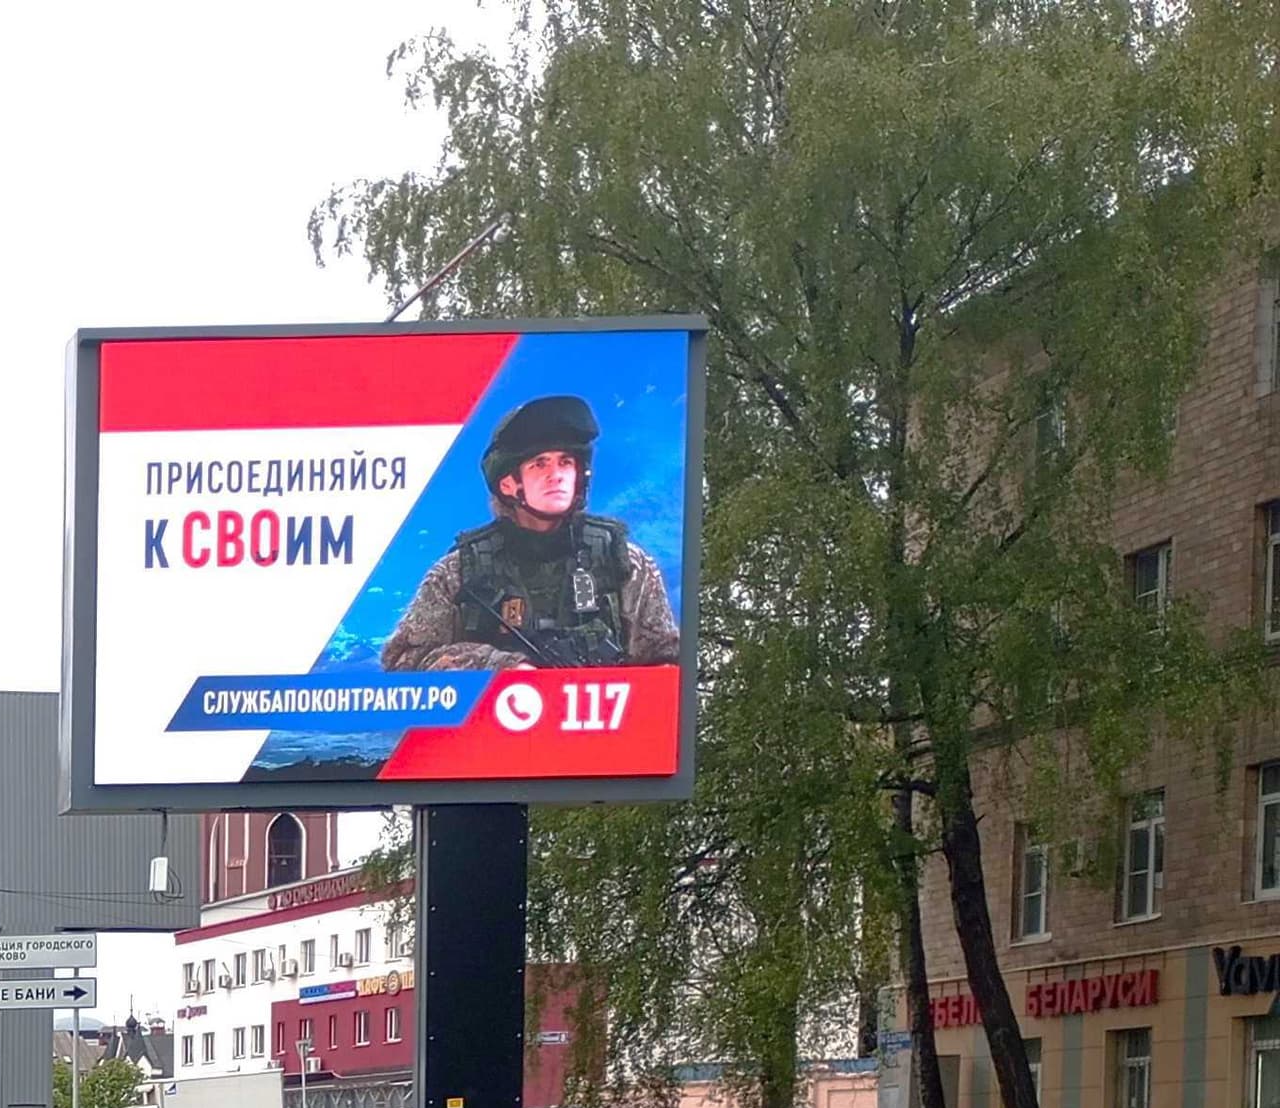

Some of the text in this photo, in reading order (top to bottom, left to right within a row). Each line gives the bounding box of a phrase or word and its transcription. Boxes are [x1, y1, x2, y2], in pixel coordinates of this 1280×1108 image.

[146, 449, 406, 497] ПРИСОЕДИНЯЙСЯ
[144, 508, 354, 569] К СВОИМ
[202, 685, 458, 716] СЛУЖБАПОКОНТРАКТУ.РФ
[559, 682, 631, 732] 117
[25, 939, 94, 951] ГОРОДСКОГО
[14, 987, 56, 1001] БАНИ
[1025, 969, 1160, 1018] БЕЛАРУСИ
